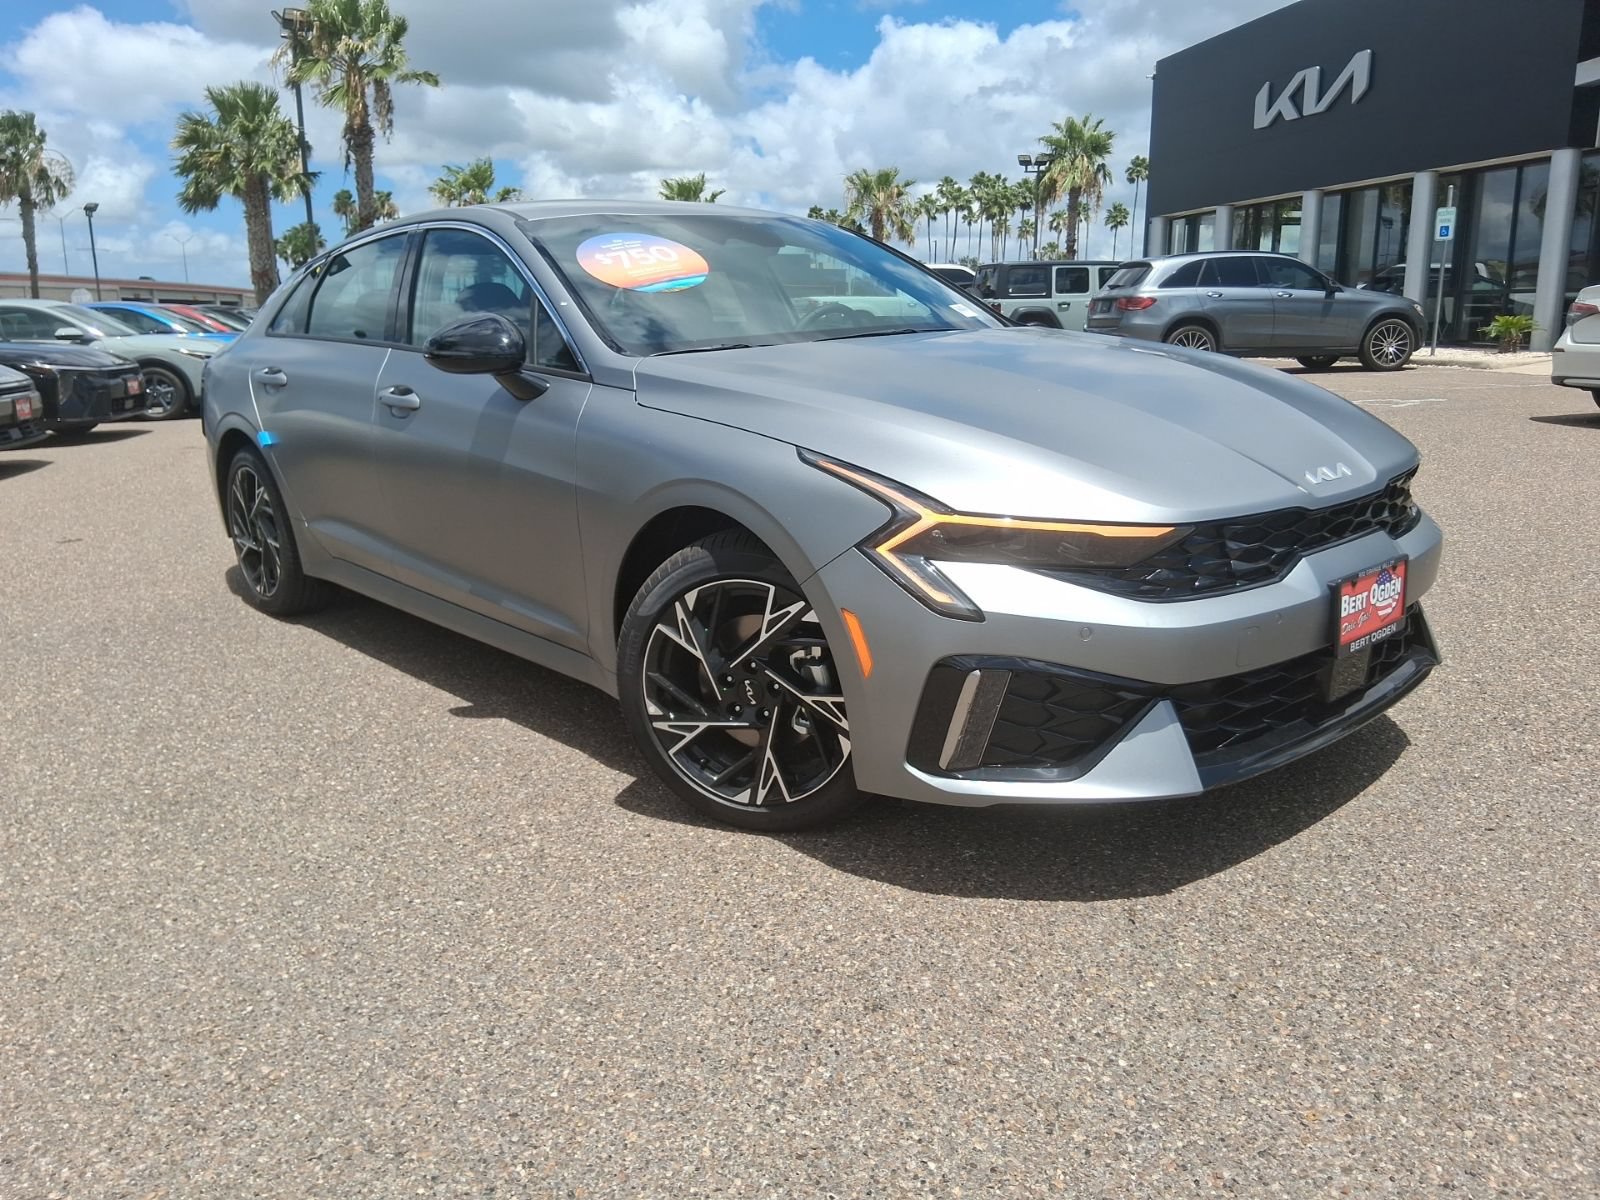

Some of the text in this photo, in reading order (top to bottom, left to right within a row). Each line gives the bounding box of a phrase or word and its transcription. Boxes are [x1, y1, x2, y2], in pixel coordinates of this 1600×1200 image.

[1253, 49, 1372, 129] KIA
[594, 245, 680, 269] $750
[1304, 462, 1352, 484] KIA
[1341, 576, 1401, 617] BERT OGDEN
[1350, 623, 1397, 652] BERT OGDEN
